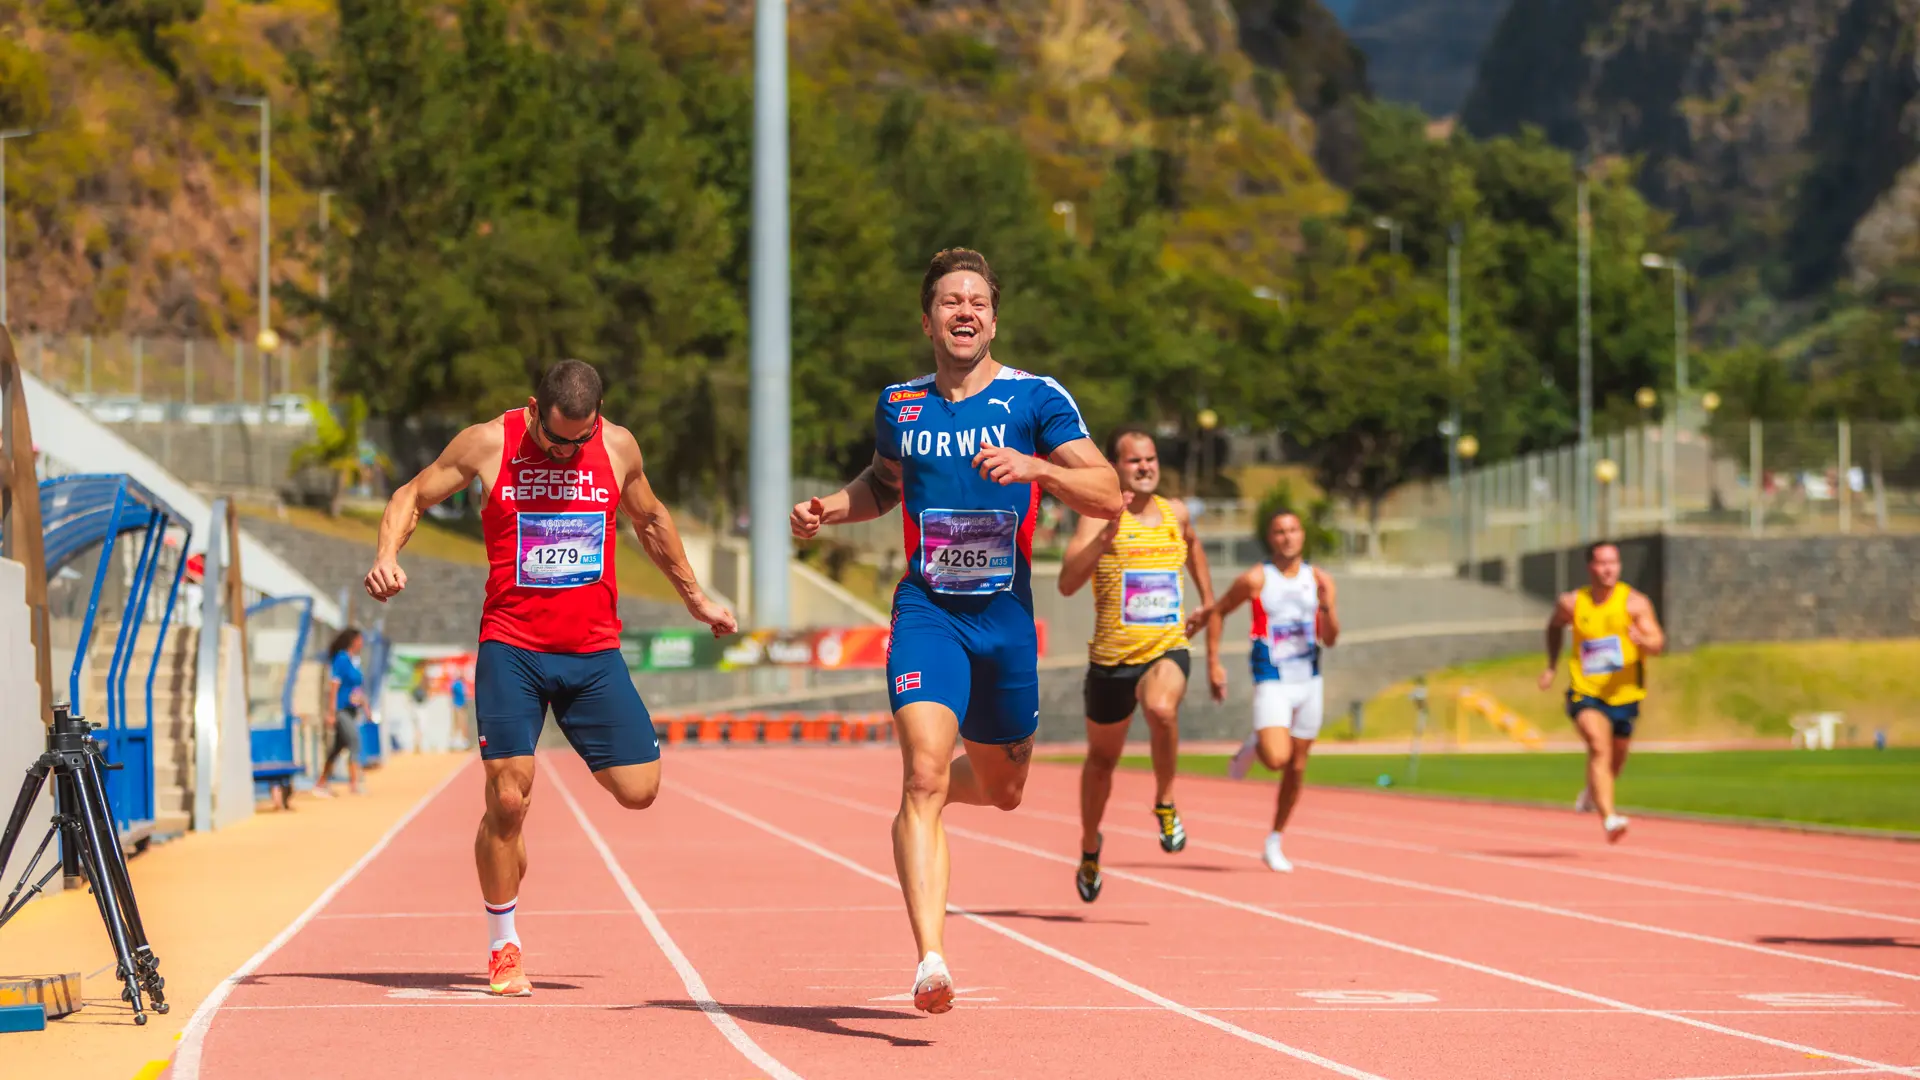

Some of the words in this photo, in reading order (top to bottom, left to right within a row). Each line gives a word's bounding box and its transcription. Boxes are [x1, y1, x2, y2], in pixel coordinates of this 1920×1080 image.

[901, 424, 1006, 457] NORWAY
[519, 469, 593, 485] CZECH
[501, 485, 609, 503] REPUBLIC
[535, 548, 579, 564] 1279
[939, 549, 988, 568] 4265
[991, 558, 1008, 566] M35
